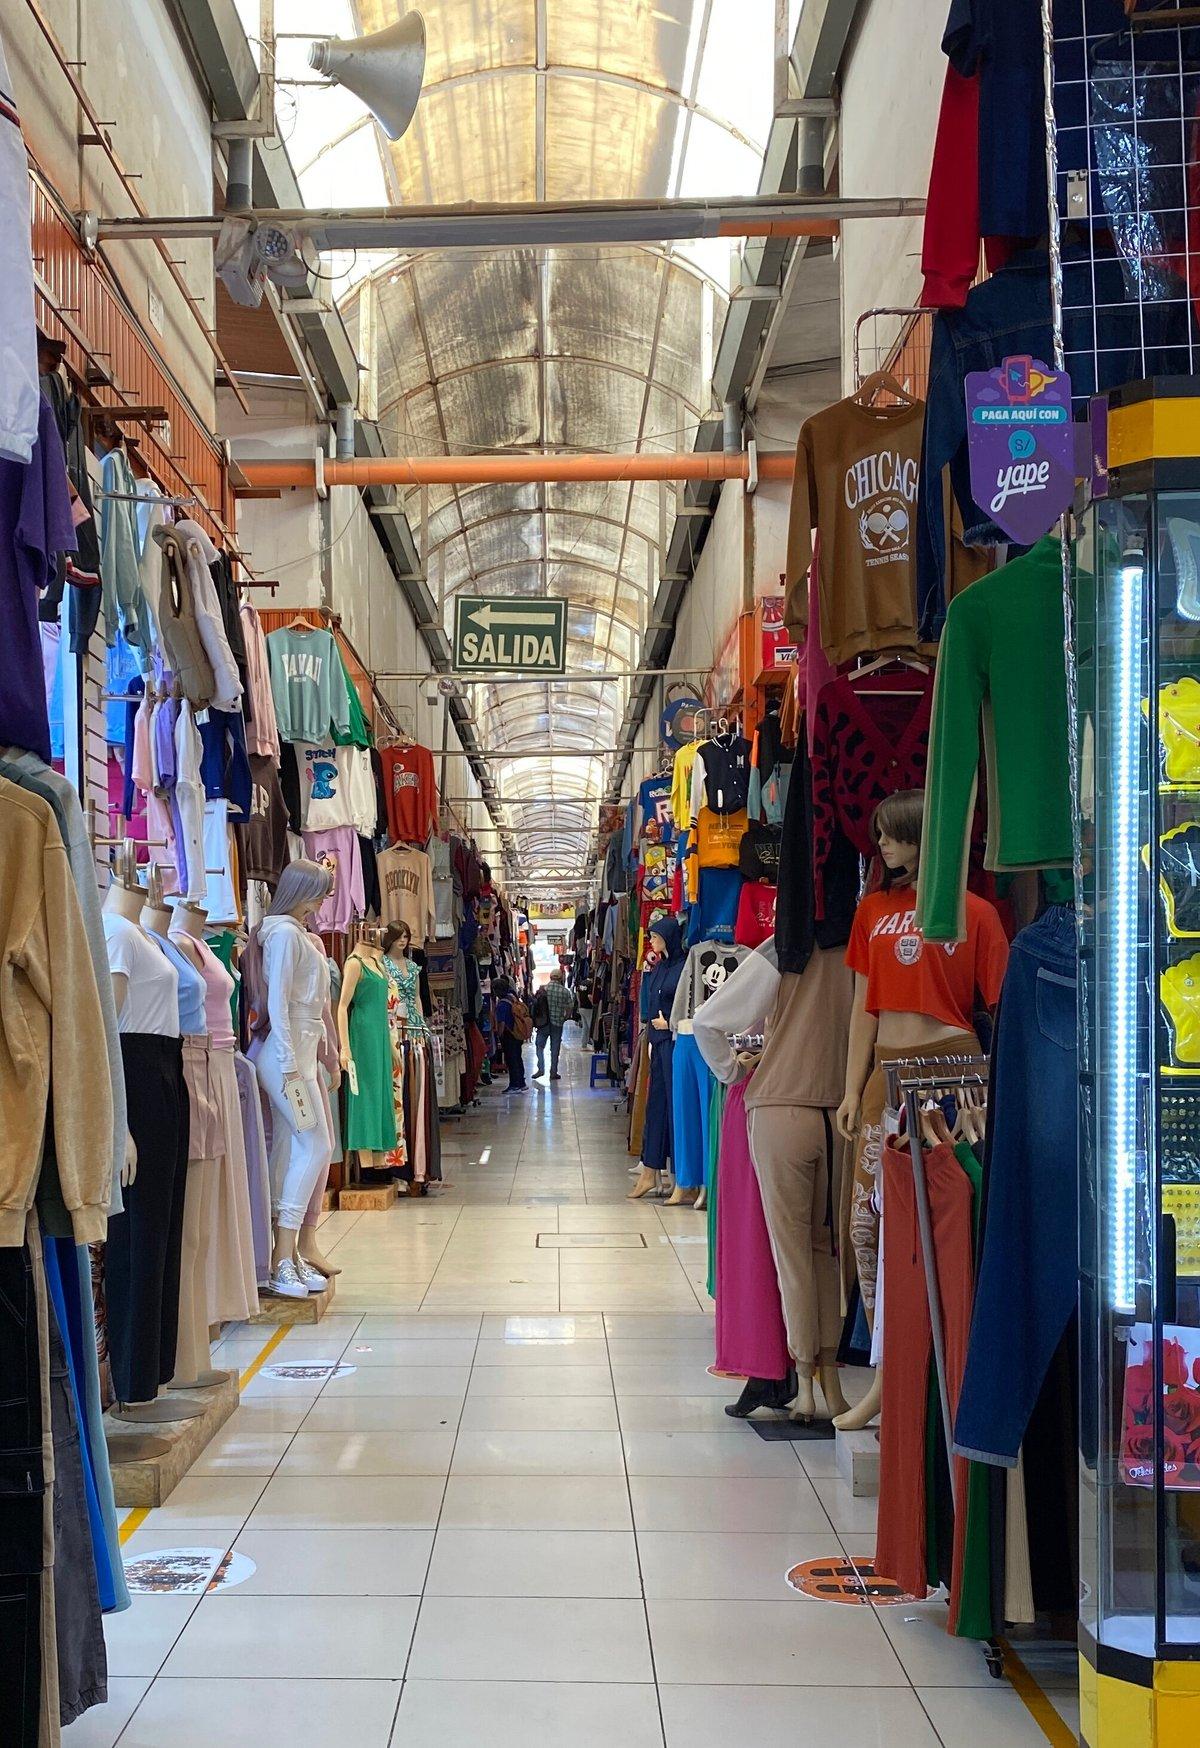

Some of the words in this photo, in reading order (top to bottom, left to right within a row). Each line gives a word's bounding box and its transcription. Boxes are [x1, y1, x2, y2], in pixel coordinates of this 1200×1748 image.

[981, 410, 1010, 420] PAGA
[1011, 408, 1037, 420] AQUÍ
[1038, 410, 1059, 420] CON
[990, 461, 1050, 512] yape
[865, 555, 889, 567] TENNIS
[462, 632, 557, 665] SALIDA
[1128, 1462, 1178, 1479] Felicides
